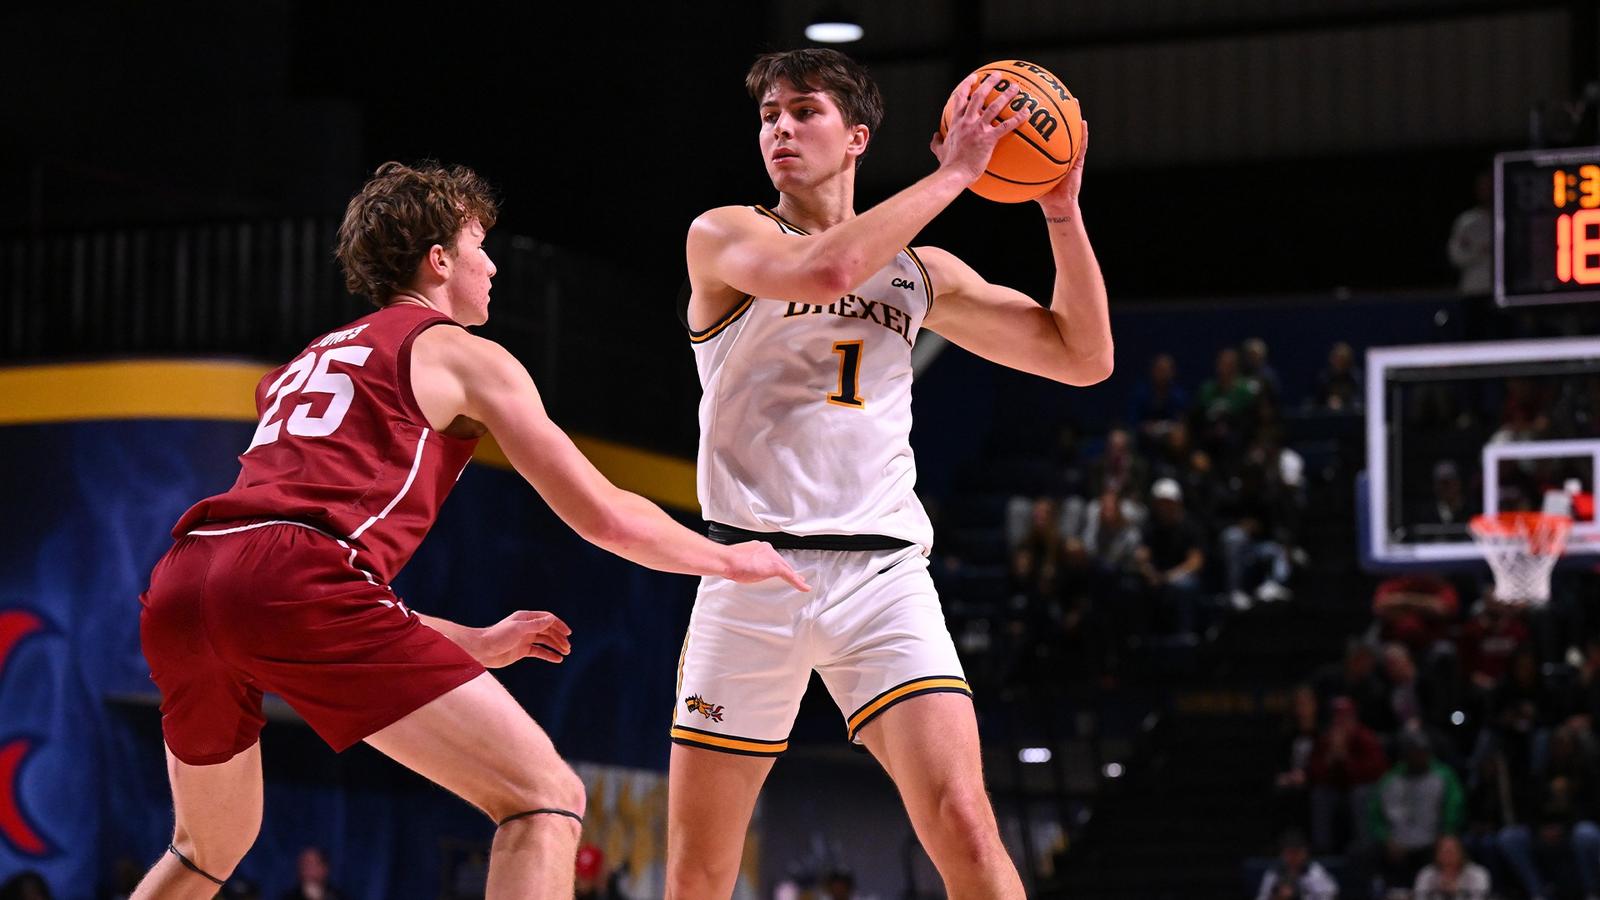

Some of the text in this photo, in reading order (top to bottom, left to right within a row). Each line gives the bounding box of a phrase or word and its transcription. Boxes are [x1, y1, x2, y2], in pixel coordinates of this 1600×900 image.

[980, 73, 1058, 143] Wilo
[1013, 60, 1071, 102] NCAA
[891, 277, 915, 291] CAA
[243, 345, 374, 456] 25
[826, 338, 865, 410] 1
